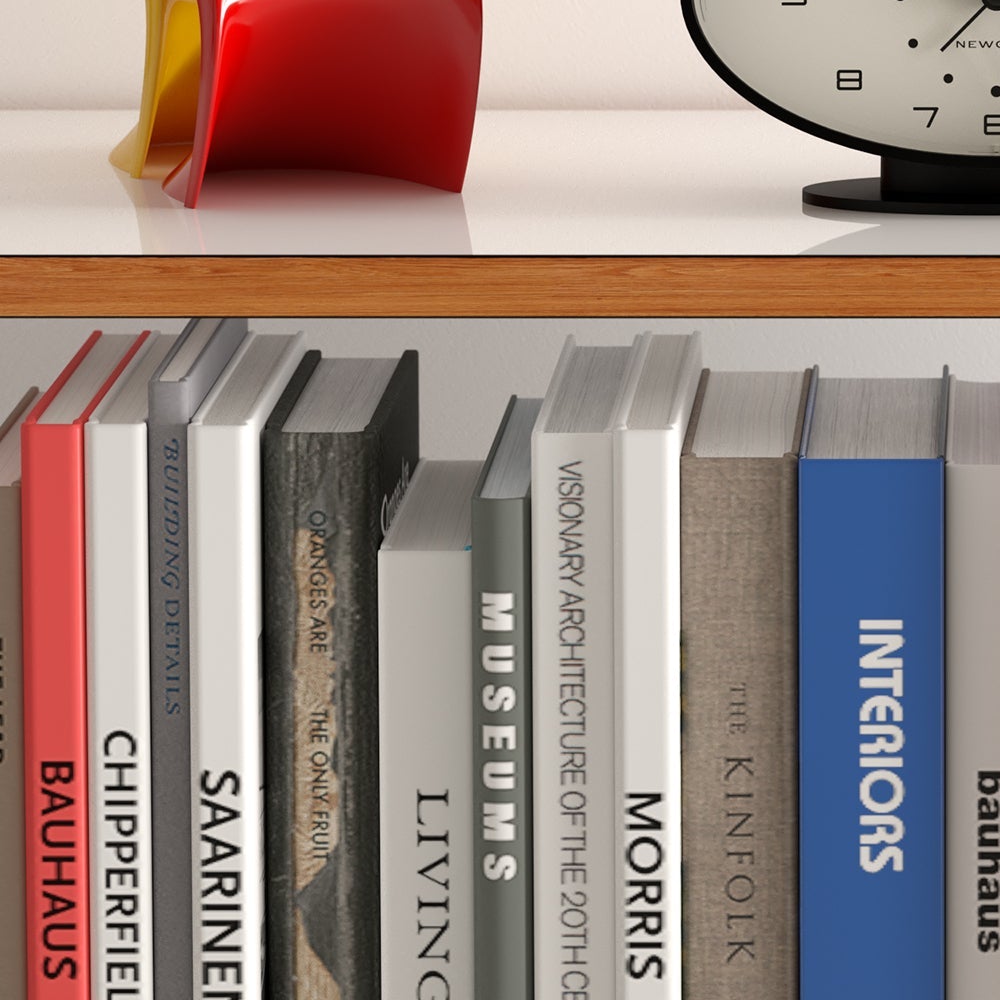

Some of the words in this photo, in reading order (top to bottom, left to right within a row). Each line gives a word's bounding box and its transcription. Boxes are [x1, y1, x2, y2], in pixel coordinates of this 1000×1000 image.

[836, 70, 863, 90] 8
[913, 107, 940, 128] 7
[161, 437, 180, 591] BUILDING
[308, 510, 329, 611] ORANGES
[558, 460, 585, 587] VISIONARY
[164, 599, 181, 716] DETAILS
[309, 616, 328, 653] ARE
[559, 590, 587, 785] ARCHITECTURE
[311, 709, 329, 744] THE
[482, 592, 518, 882] MUSEUMS
[729, 682, 747, 735] THE
[859, 619, 904, 873] INTERIORS
[311, 751, 330, 801] ONLY
[560, 791, 587, 827] OF
[40, 761, 77, 980] BAUHAUS
[104, 730, 140, 1000] CHIPPERFIEL
[311, 810, 330, 862] FRUIT
[560, 831, 587, 885] THE
[626, 793, 664, 980] MORRIS
[724, 757, 755, 963] KINFOLK
[416, 789, 450, 1000] LIVING
[561, 891, 588, 965] 20TH
